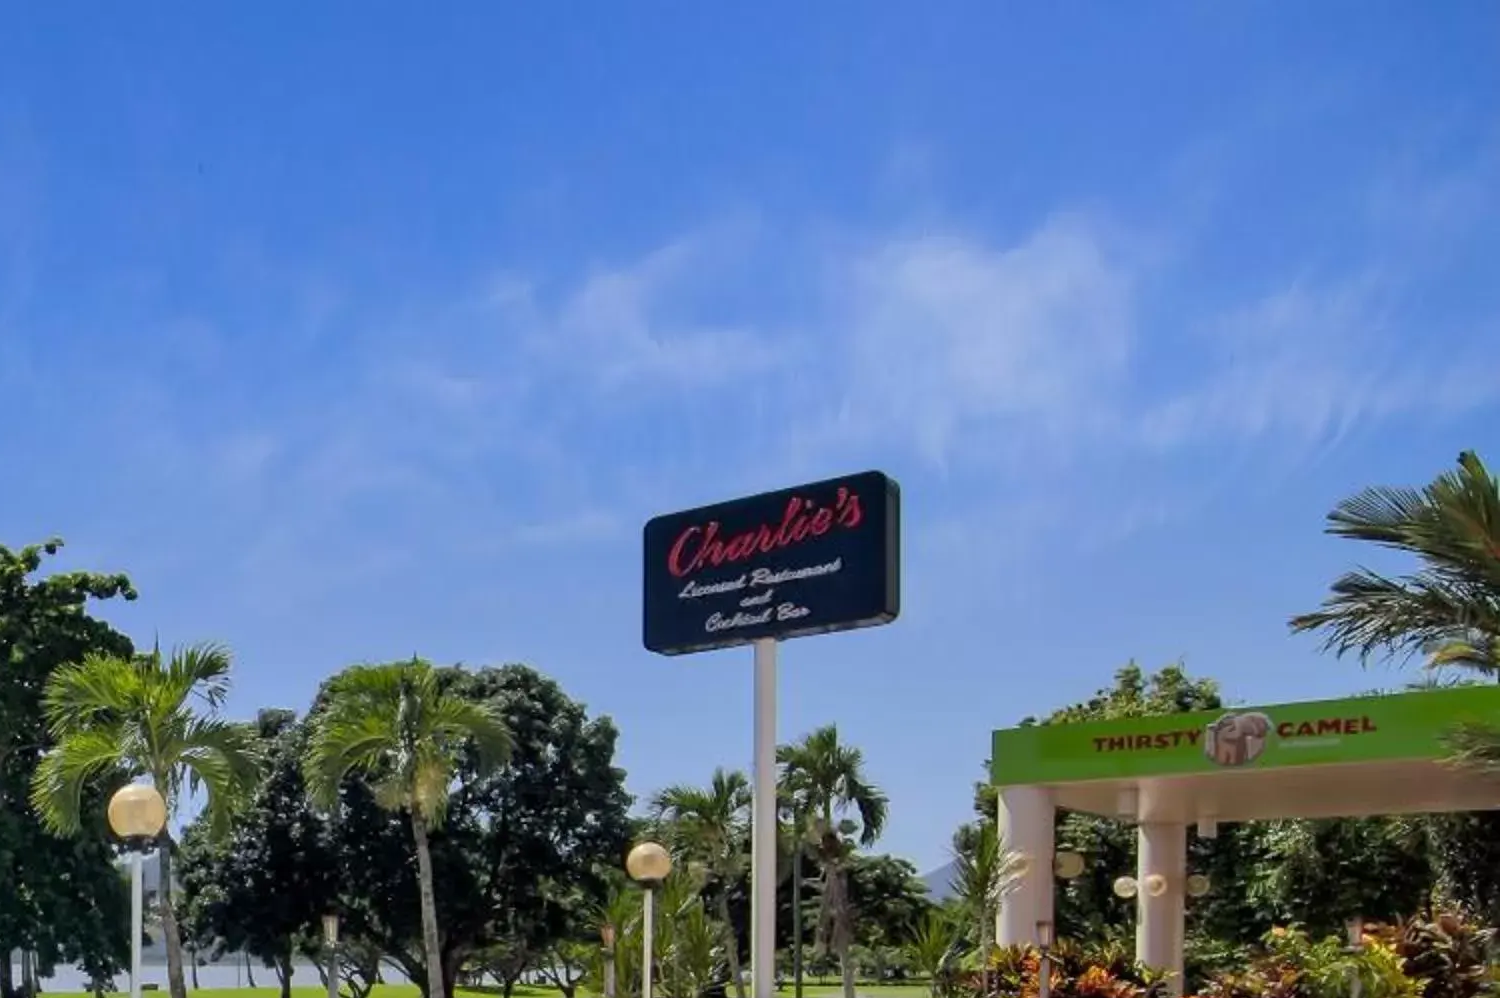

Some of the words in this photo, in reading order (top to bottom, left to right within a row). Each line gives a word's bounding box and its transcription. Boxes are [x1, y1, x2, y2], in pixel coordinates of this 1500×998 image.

[668, 486, 863, 578] Charlie's
[749, 556, 842, 586] Restaurant
[739, 588, 774, 607] and
[705, 607, 773, 632] Cocktail
[776, 602, 812, 622] Bar
[1093, 728, 1202, 753] THIRSTY
[1276, 715, 1378, 740] CAMEL
